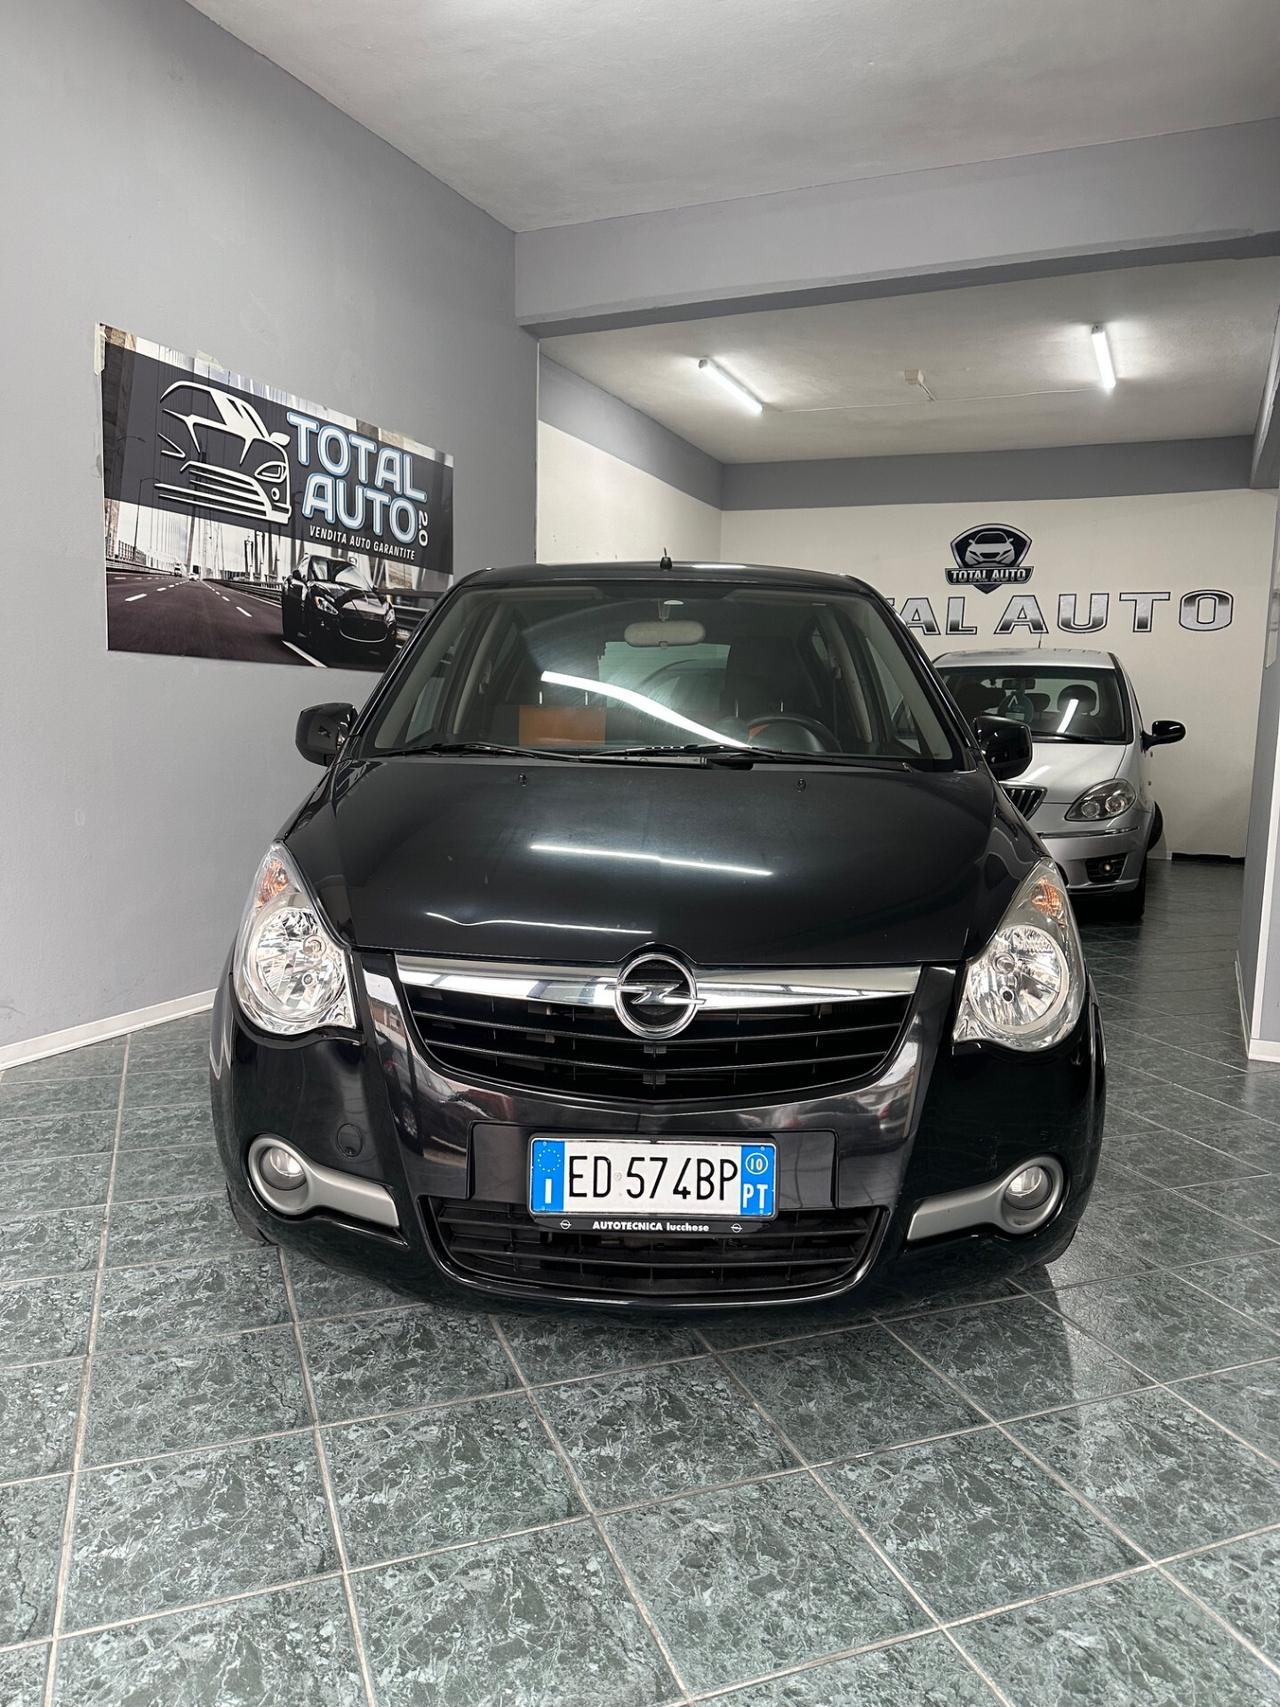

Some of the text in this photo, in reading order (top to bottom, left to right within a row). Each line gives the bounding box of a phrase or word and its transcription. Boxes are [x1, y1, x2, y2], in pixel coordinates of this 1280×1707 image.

[286, 411, 428, 503] TOTAL
[301, 472, 418, 544] AUTO
[309, 525, 416, 561] VENDITA AUTO GARANTITE
[951, 569, 1026, 582] TOTAL AUTO
[993, 589, 1234, 636] AUTO
[568, 1155, 738, 1201] ED 574BP
[742, 1184, 768, 1209] PT
[592, 1220, 709, 1233] AUTOTECNICA lucchese
